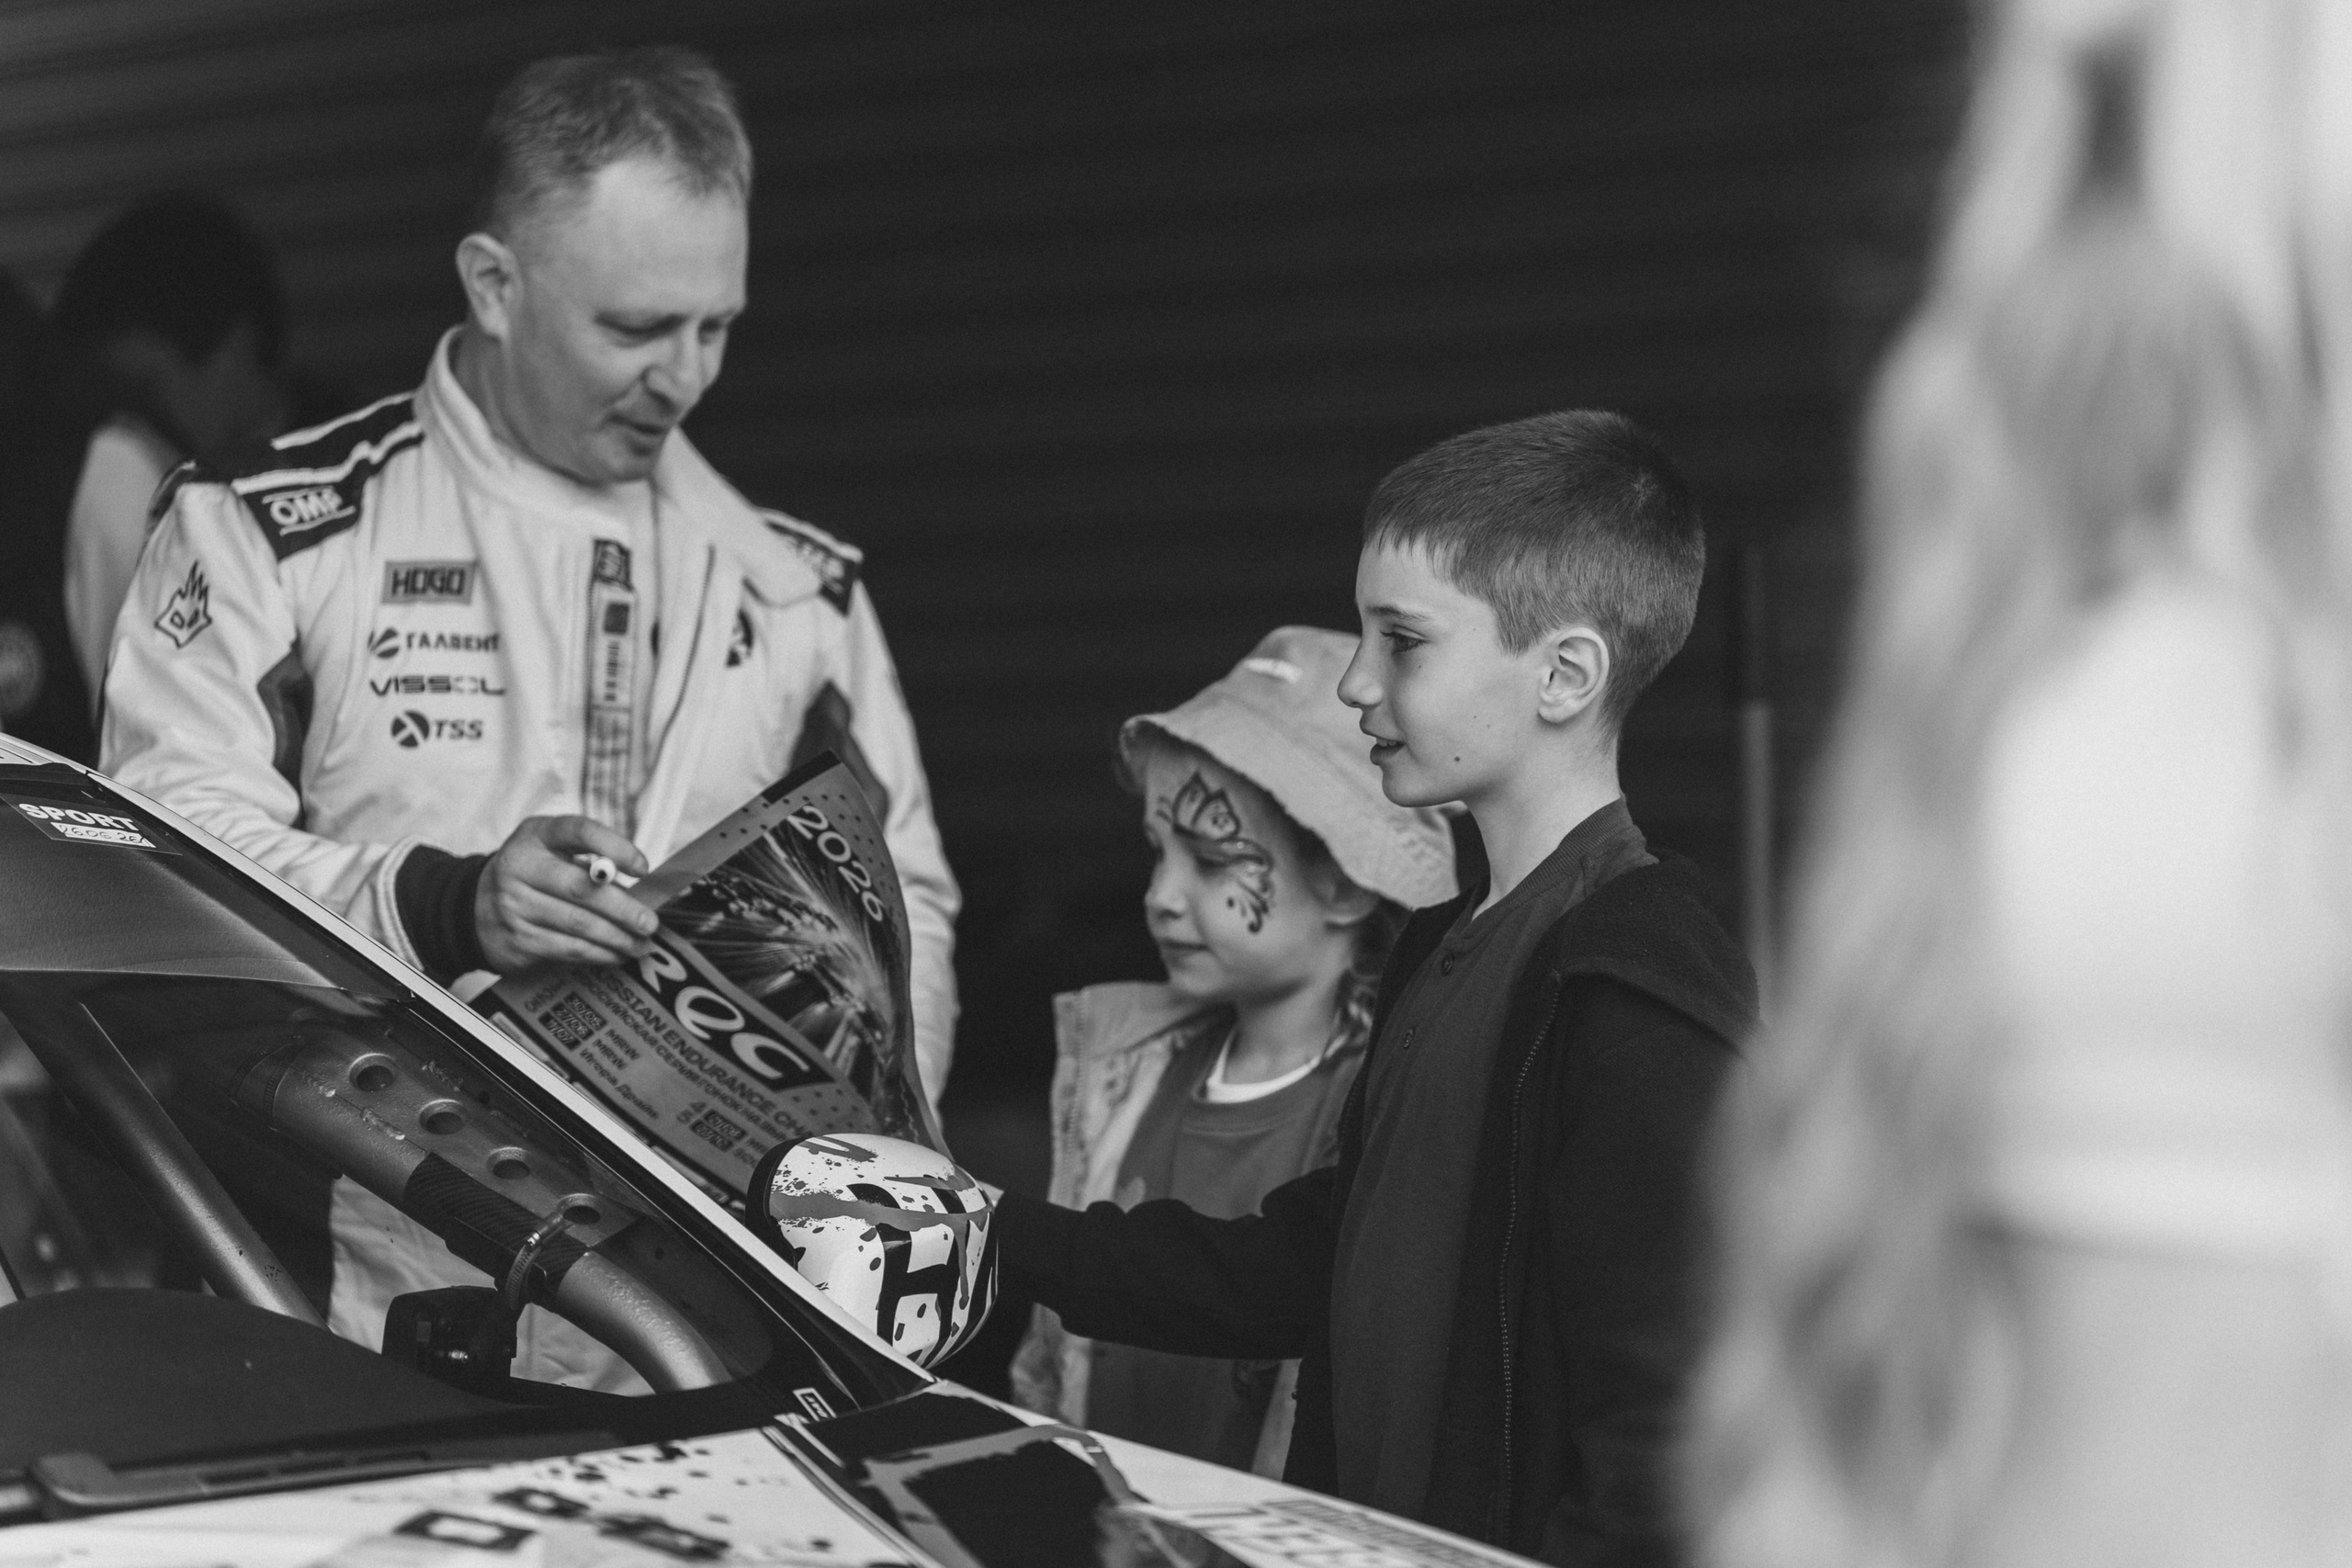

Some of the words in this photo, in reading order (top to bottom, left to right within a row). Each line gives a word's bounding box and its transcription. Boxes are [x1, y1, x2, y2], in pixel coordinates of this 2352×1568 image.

[434, 719, 483, 740] TSS
[18, 803, 139, 831] SPORT
[786, 804, 884, 923] 2026
[661, 1029, 777, 1113] ENDURANCE
